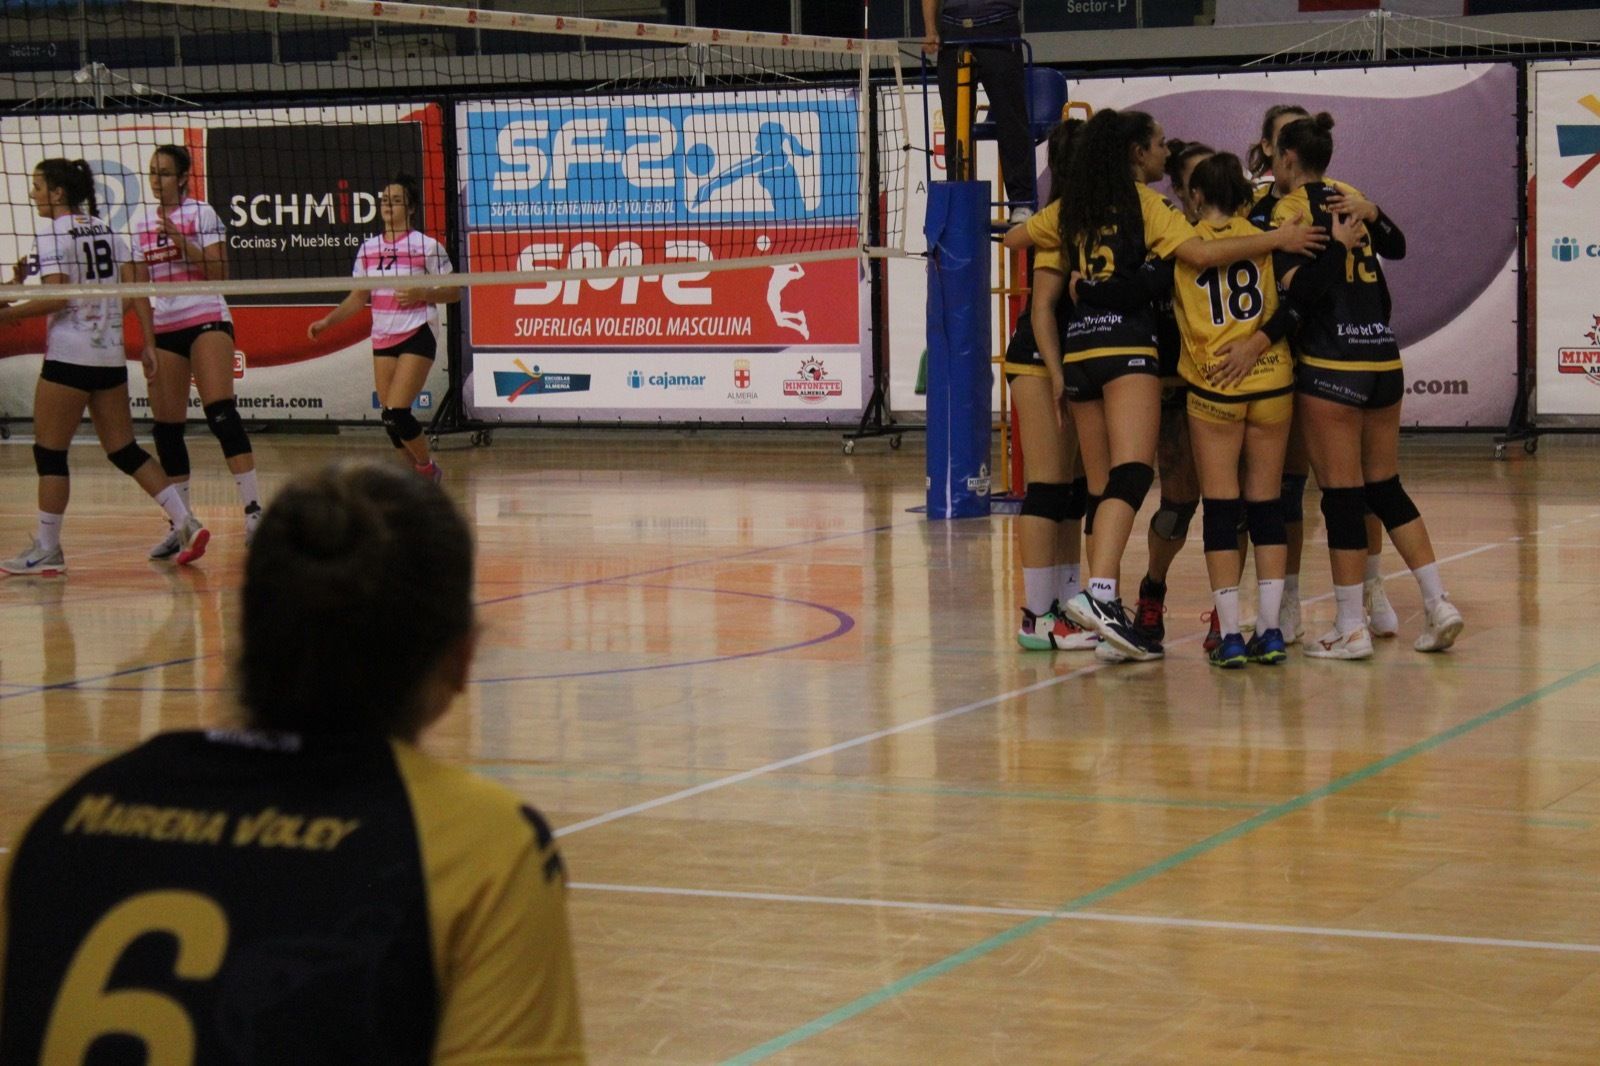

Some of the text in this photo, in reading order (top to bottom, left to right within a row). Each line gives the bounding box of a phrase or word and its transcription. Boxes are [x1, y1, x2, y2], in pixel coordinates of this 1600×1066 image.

[230, 179, 384, 227] SCHMiD
[490, 199, 676, 217] SUPERLIGA FEMENINA DE VOLEIBOL
[230, 235, 277, 249] Cocinas
[279, 238, 288, 252] y
[291, 233, 341, 248] Muebles
[344, 233, 359, 247] de
[377, 255, 397, 270] 17
[1195, 260, 1263, 326] 18
[514, 316, 752, 337] SUPERLIGA VOLEIBOL MASCULINA
[648, 371, 706, 390] cajamar
[785, 381, 841, 390] MINTONETTE
[1091, 582, 1112, 591] FILA
[39, 888, 231, 1066] 6
